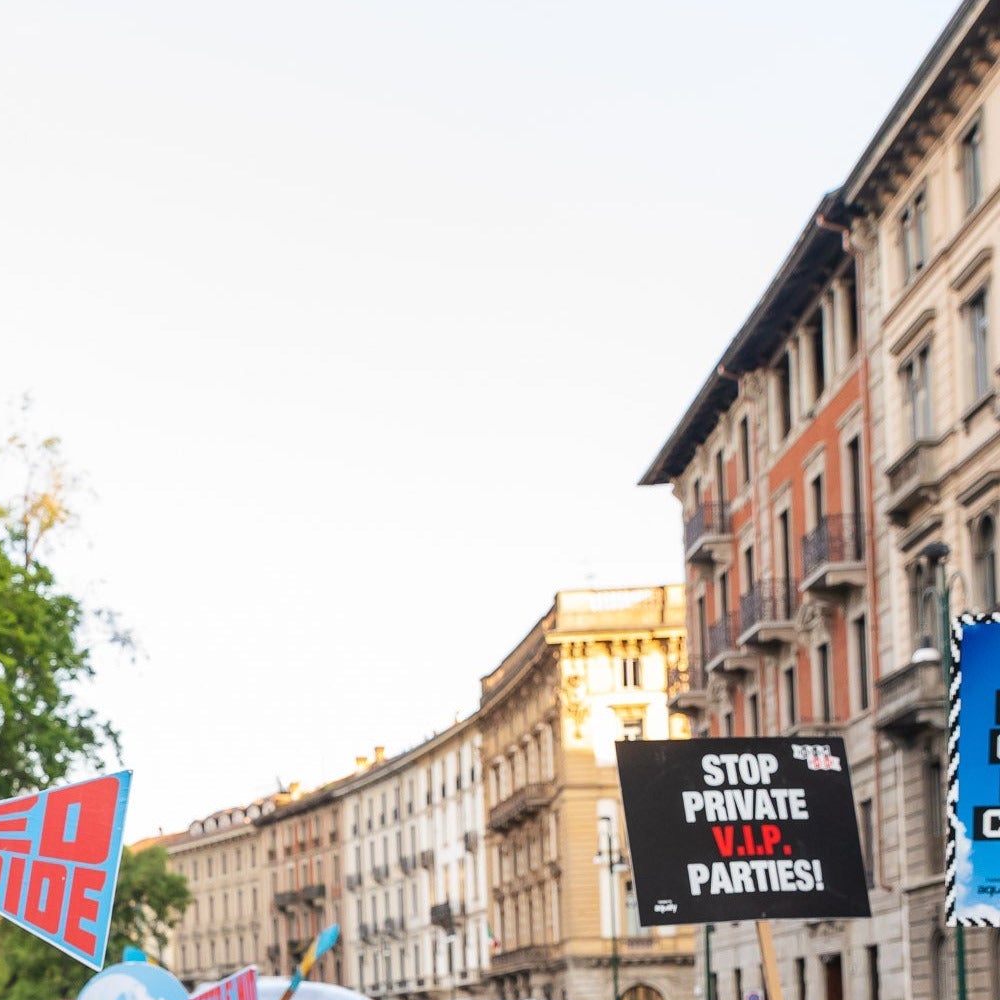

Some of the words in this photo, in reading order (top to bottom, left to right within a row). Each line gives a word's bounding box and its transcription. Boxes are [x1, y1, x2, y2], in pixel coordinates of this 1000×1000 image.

[702, 753, 779, 786] STOP
[682, 788, 809, 823] PRIVATE
[712, 824, 792, 857] V.I.P.
[687, 859, 824, 896] PARTIES!
